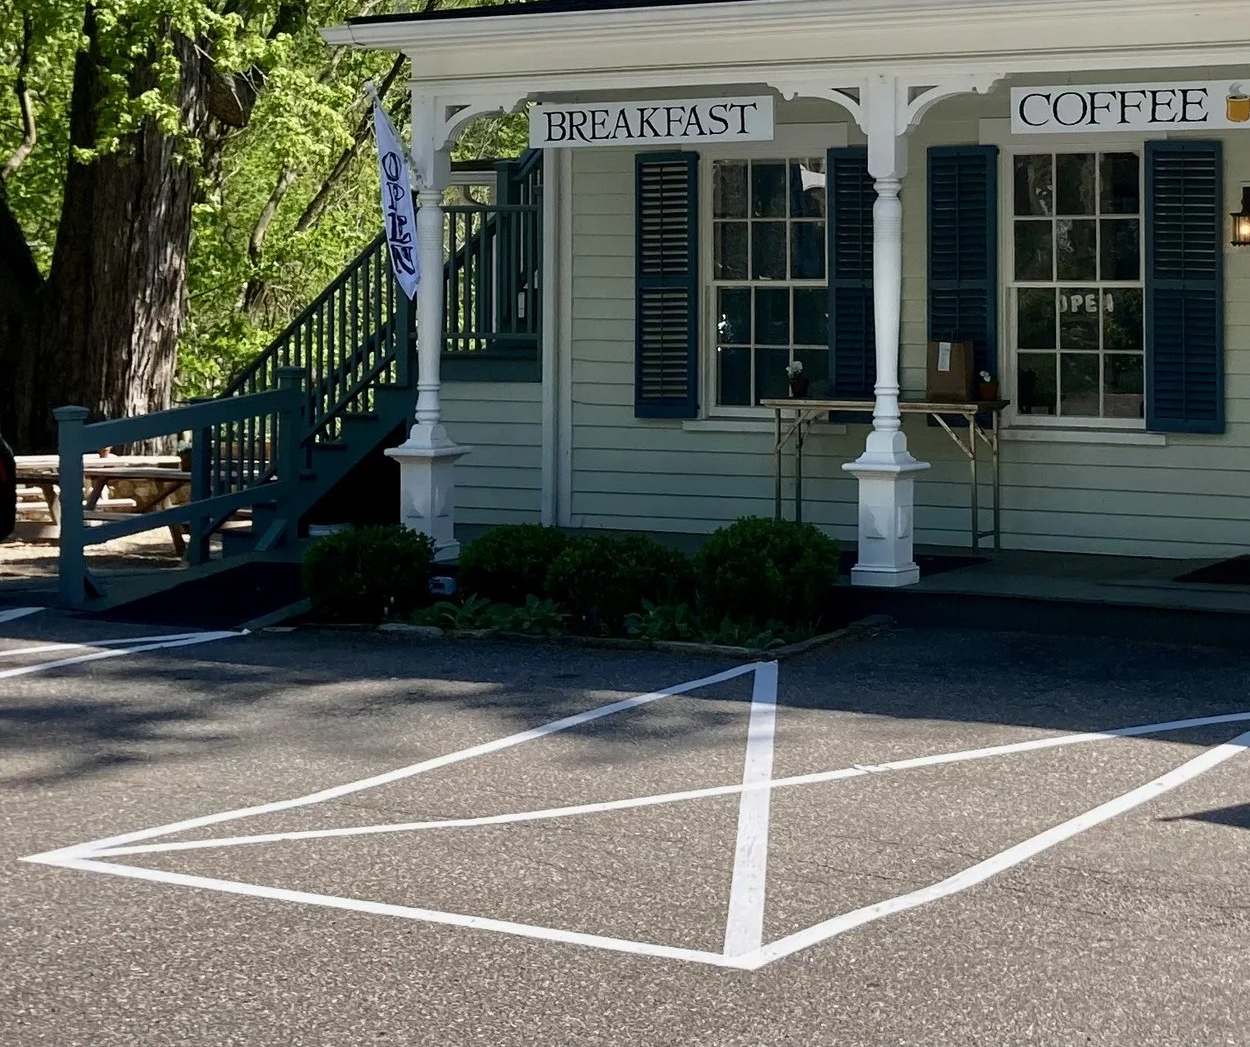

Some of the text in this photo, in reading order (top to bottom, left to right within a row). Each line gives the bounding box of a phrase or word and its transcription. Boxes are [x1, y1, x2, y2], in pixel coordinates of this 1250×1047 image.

[543, 102, 758, 143] BREAKFAST
[1018, 88, 1209, 126] COFFEE
[381, 151, 416, 275] OPEN
